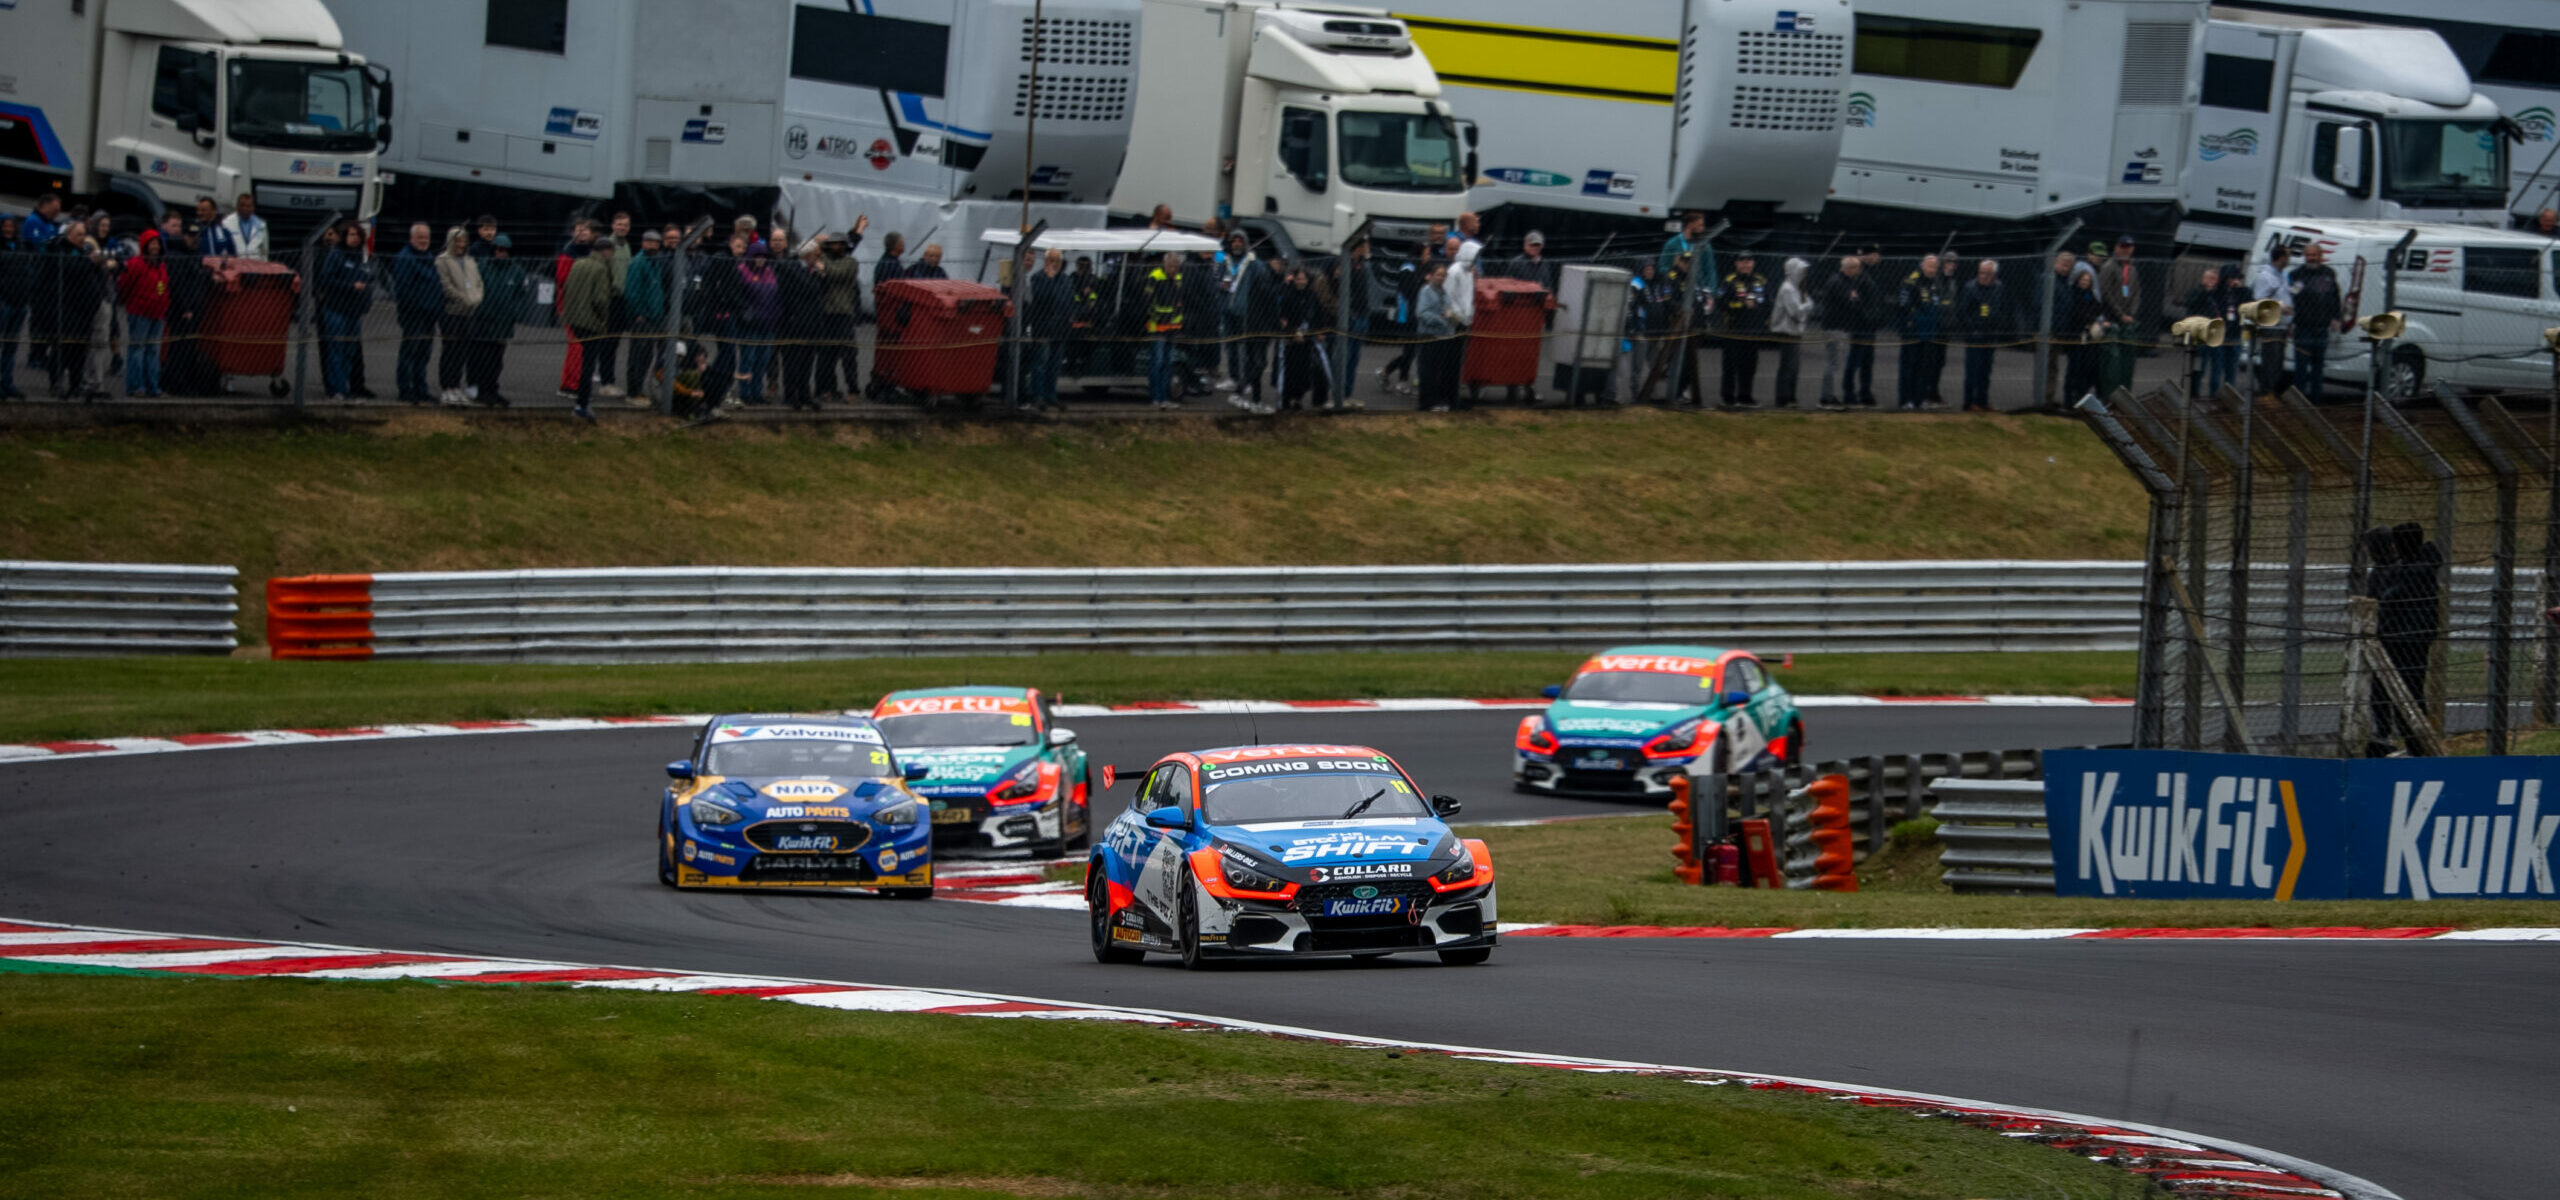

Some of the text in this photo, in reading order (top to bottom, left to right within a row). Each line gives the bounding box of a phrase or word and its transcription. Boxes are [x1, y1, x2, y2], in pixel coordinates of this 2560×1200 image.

[789, 132, 808, 151] H5
[290, 196, 327, 207] DAF
[1600, 656, 1691, 673] vertu
[896, 697, 1001, 713] vertu
[769, 728, 874, 740] Valvoline
[870, 751, 890, 765] 27
[1208, 762, 1310, 780] COMING
[1317, 760, 1390, 772] SOON
[776, 785, 835, 795] NAPA
[1390, 780, 1411, 794] 11
[766, 806, 850, 818] AUTO PARTS
[777, 836, 833, 850] KwikFit
[1340, 834, 1406, 845] FILM
[2383, 779, 2560, 901] Kwik
[1282, 841, 1421, 863] SHIFT
[1333, 864, 1412, 876] COLLARD
[1331, 897, 1392, 916] KwikFit
